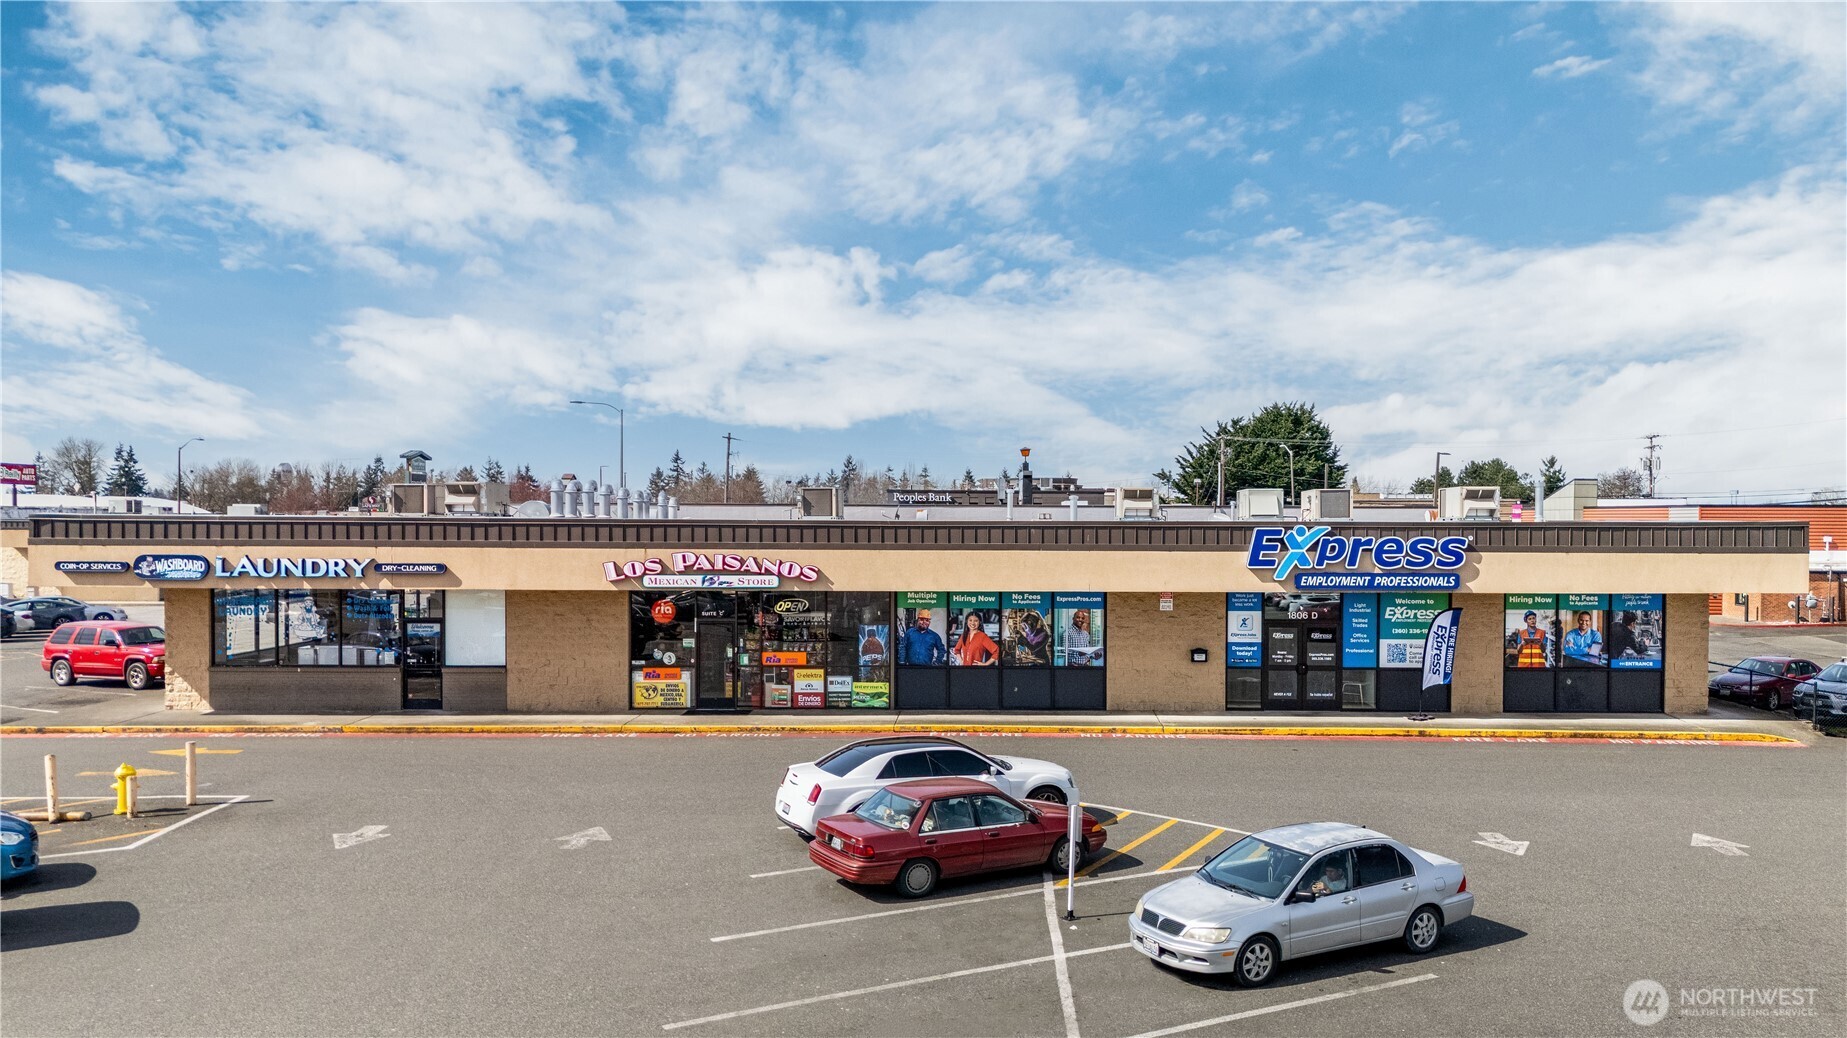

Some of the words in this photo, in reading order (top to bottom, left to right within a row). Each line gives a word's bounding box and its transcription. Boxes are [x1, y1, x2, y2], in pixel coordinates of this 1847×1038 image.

[893, 493, 927, 504] Peoples
[928, 493, 953, 502] Bank
[155, 558, 206, 573] WASHBOARD
[215, 554, 374, 578] LAUNDRY
[381, 564, 438, 572] DRY-CLEANING
[603, 558, 662, 582] LOS
[671, 552, 819, 582] PAISANOS
[647, 577, 698, 586] MEXICAN
[737, 577, 775, 586] STORE
[1300, 576, 1371, 587] EMPLOYMENT
[1374, 576, 1456, 587] PROFESSIONALS
[953, 595, 977, 603] Hiring
[1509, 596, 1533, 604] Hiring
[655, 602, 672, 614] ria
[776, 601, 805, 611] OPEN
[1449, 626, 1458, 647] WE'RE
[765, 654, 781, 663] Ria
[1445, 647, 1455, 673] HIRING!
[644, 670, 661, 678] Ria
